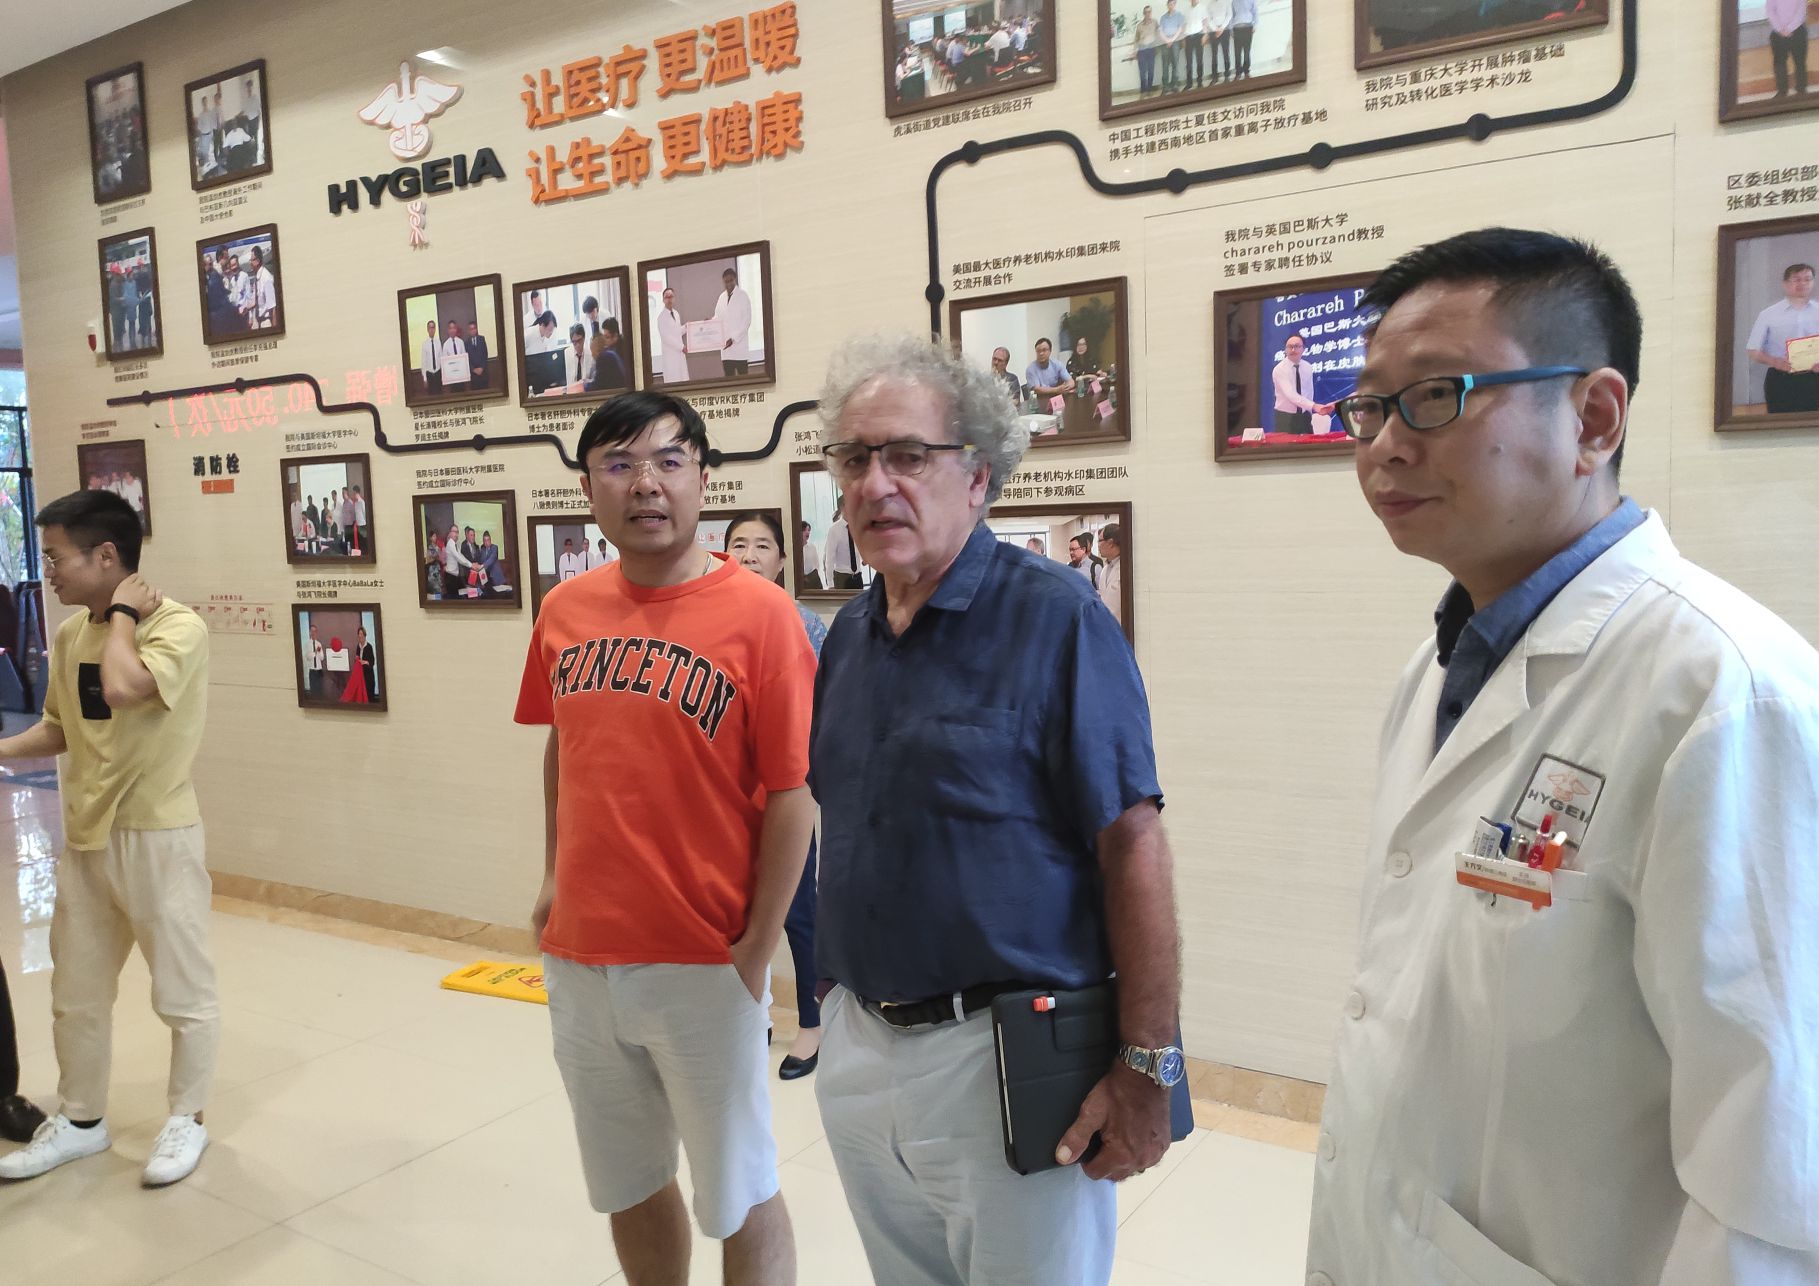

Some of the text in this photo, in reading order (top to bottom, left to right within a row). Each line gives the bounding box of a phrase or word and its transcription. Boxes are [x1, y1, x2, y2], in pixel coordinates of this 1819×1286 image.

[1364, 42, 1566, 95] 我院与重庆大学开展肿瘤基础
[1364, 68, 1533, 112] 研究及转化医学学术沙龙
[893, 97, 1034, 138] 虎溪街道党建联席会在我院召开
[1108, 97, 1287, 144] 中国工程院院士夏佳文访问我院
[1109, 108, 1329, 162] 携手共建西南地区首家重离子放疗基地
[327, 147, 506, 215] HYGEIA
[1728, 164, 1819, 191] 区委组织部
[1726, 185, 1819, 212] 张献全教授
[1224, 212, 1349, 243] 我院与英国巴斯大学
[952, 239, 1121, 276] 美国最大医疗养老机构水印集团来院
[1223, 237, 1284, 259] charareh
[1223, 250, 1334, 278] 签署专家聘任协议
[952, 272, 1014, 291] 交流开展合作
[1274, 295, 1345, 327] Charareh
[1353, 288, 1367, 308] P
[527, 407, 600, 422] 日本著名肝胆外科专家
[529, 421, 575, 433] 博士为患者面诊
[794, 430, 822, 442] 张鸿飞
[192, 452, 240, 476] 消防栓
[1002, 485, 1086, 500] 导陪同下参观病区
[552, 637, 737, 743] RINCETON
